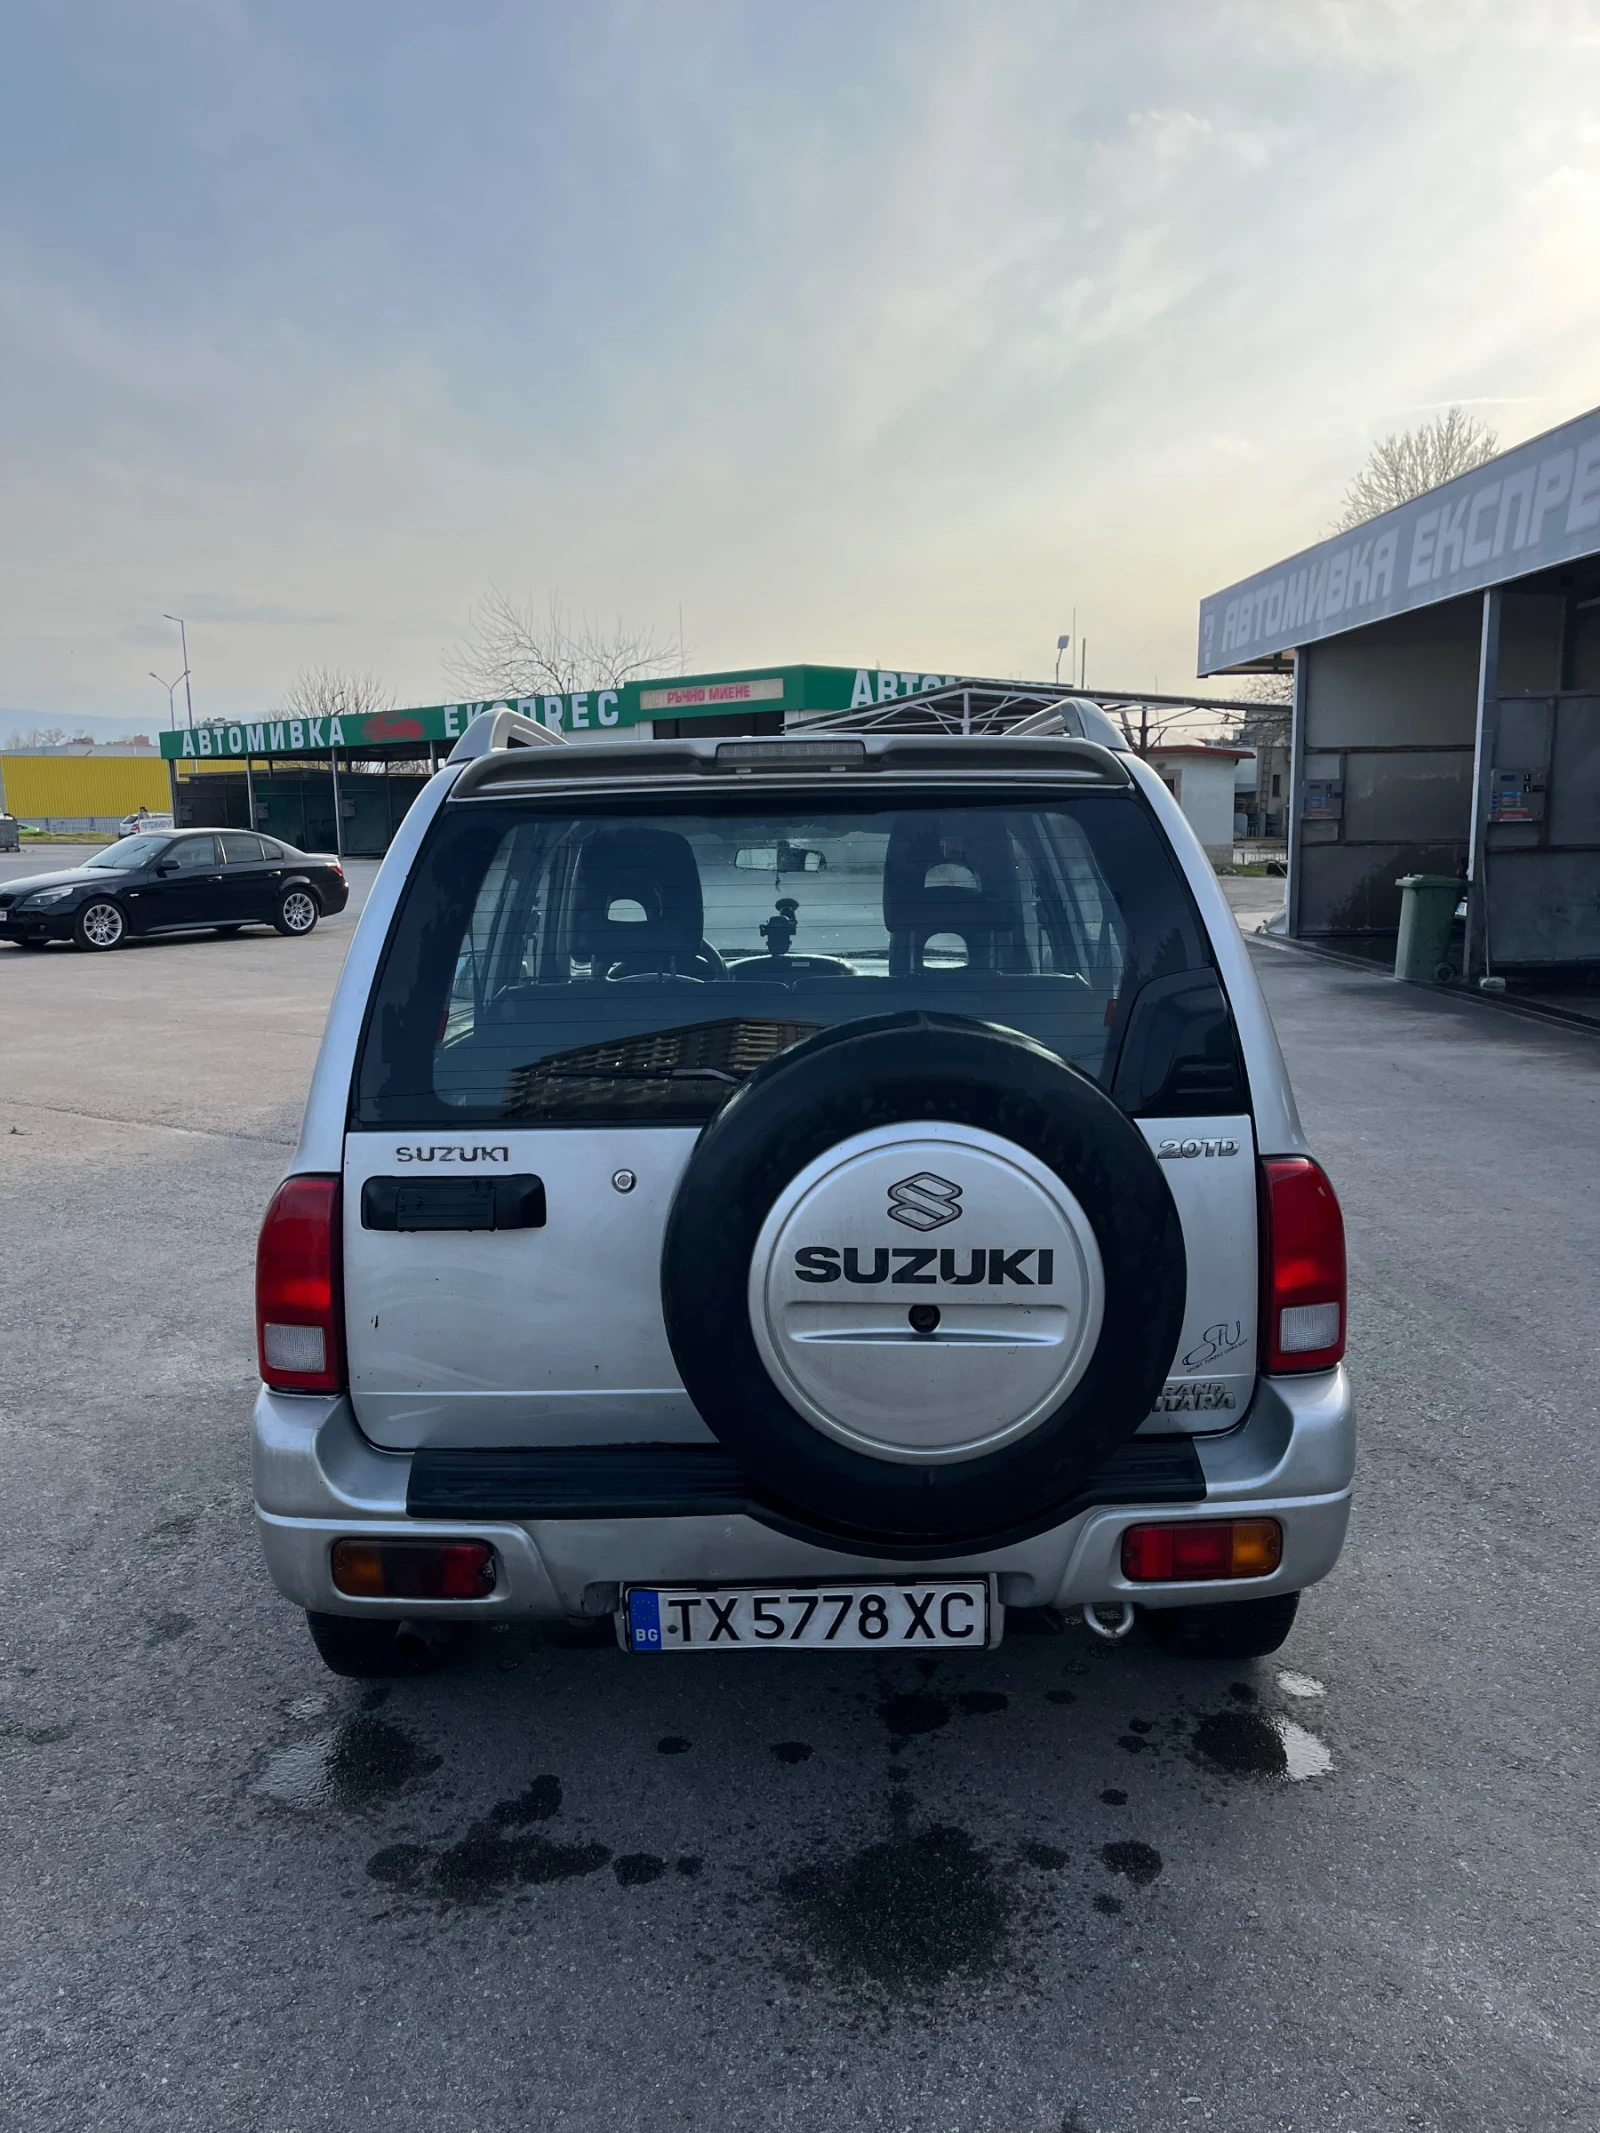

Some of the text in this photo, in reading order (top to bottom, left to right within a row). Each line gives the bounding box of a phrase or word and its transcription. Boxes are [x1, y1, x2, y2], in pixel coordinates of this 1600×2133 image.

[1222, 526, 1400, 653] АВТОМИВКА
[667, 689, 705, 704] РЪЧНО
[709, 685, 750, 700] МИЕНЕ
[182, 691, 619, 757] АВТОМИВКА ЕКПРЕС
[396, 1146, 509, 1162] SUZUKI
[795, 1246, 1053, 1285] SUZUKI
[1161, 1382, 1226, 1396] RAND
[1152, 1392, 1236, 1413] ITARA
[636, 1628, 658, 1642] BG
